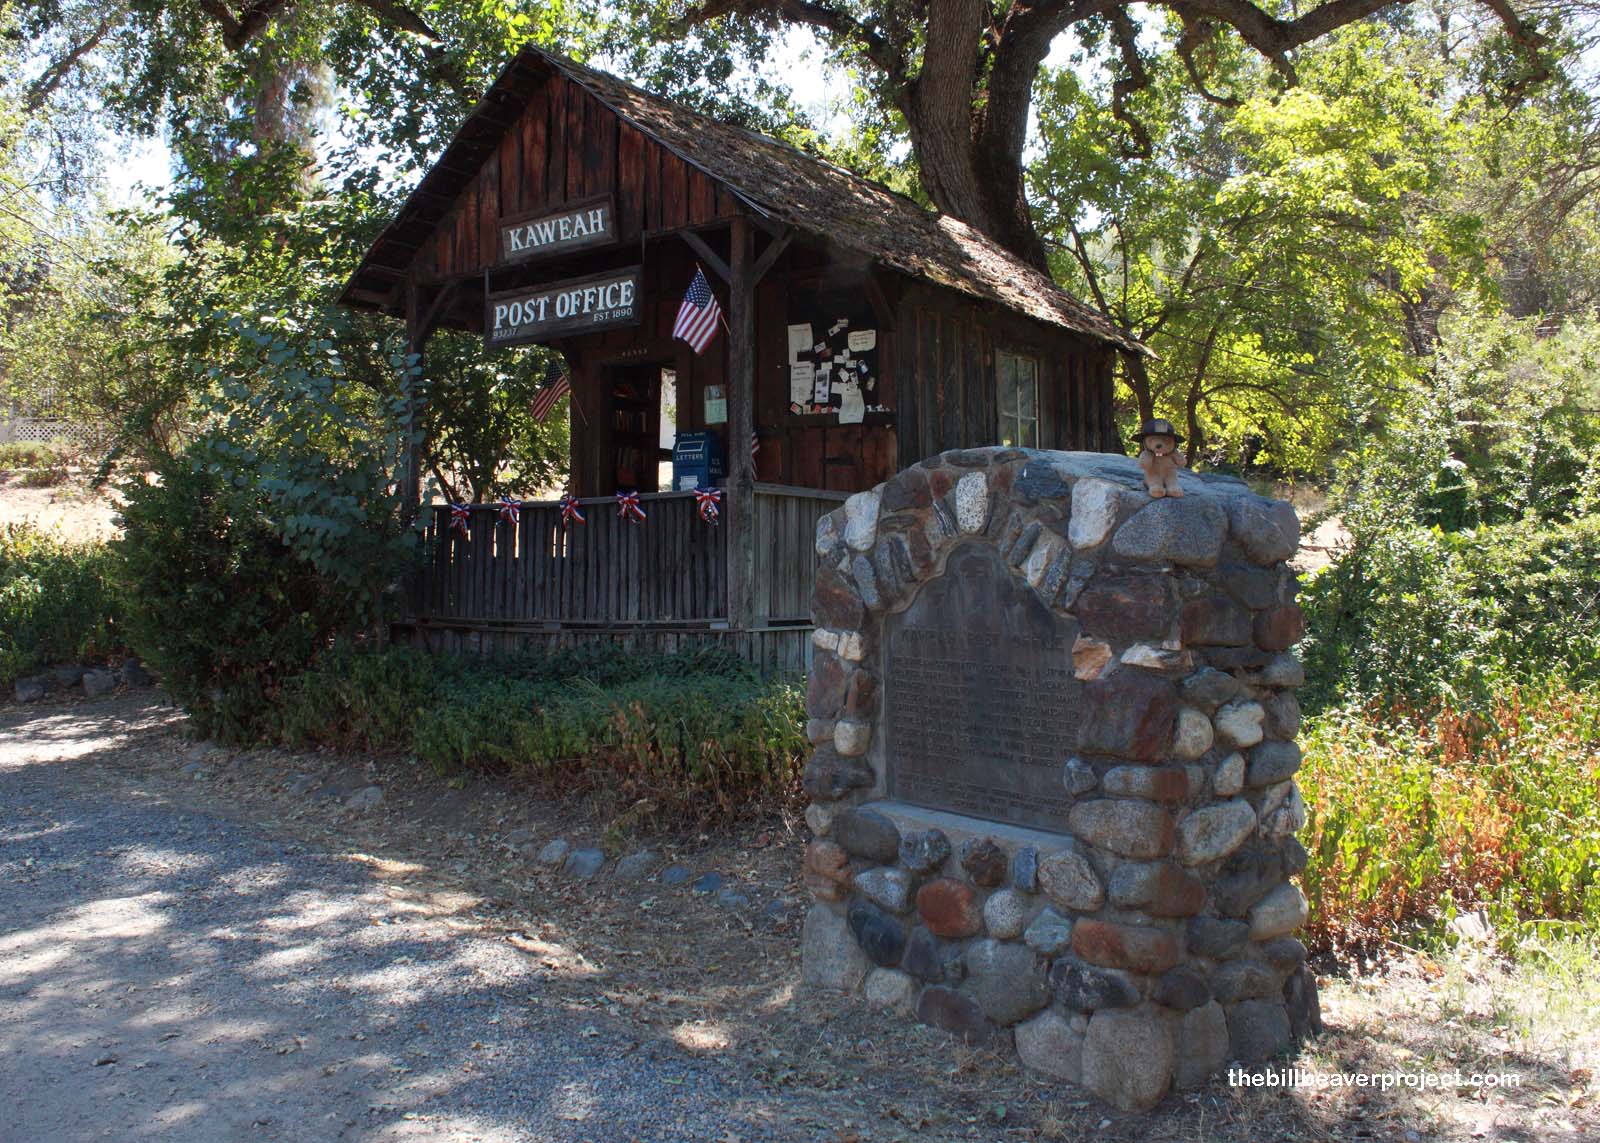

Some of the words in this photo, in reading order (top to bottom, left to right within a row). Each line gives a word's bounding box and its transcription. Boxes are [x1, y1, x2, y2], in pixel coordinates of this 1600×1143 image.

[508, 207, 605, 251] KAWEAH
[493, 295, 550, 329] POST
[556, 279, 634, 318] OFFICE
[612, 307, 633, 319] 1890
[675, 453, 704, 461] LETTERS
